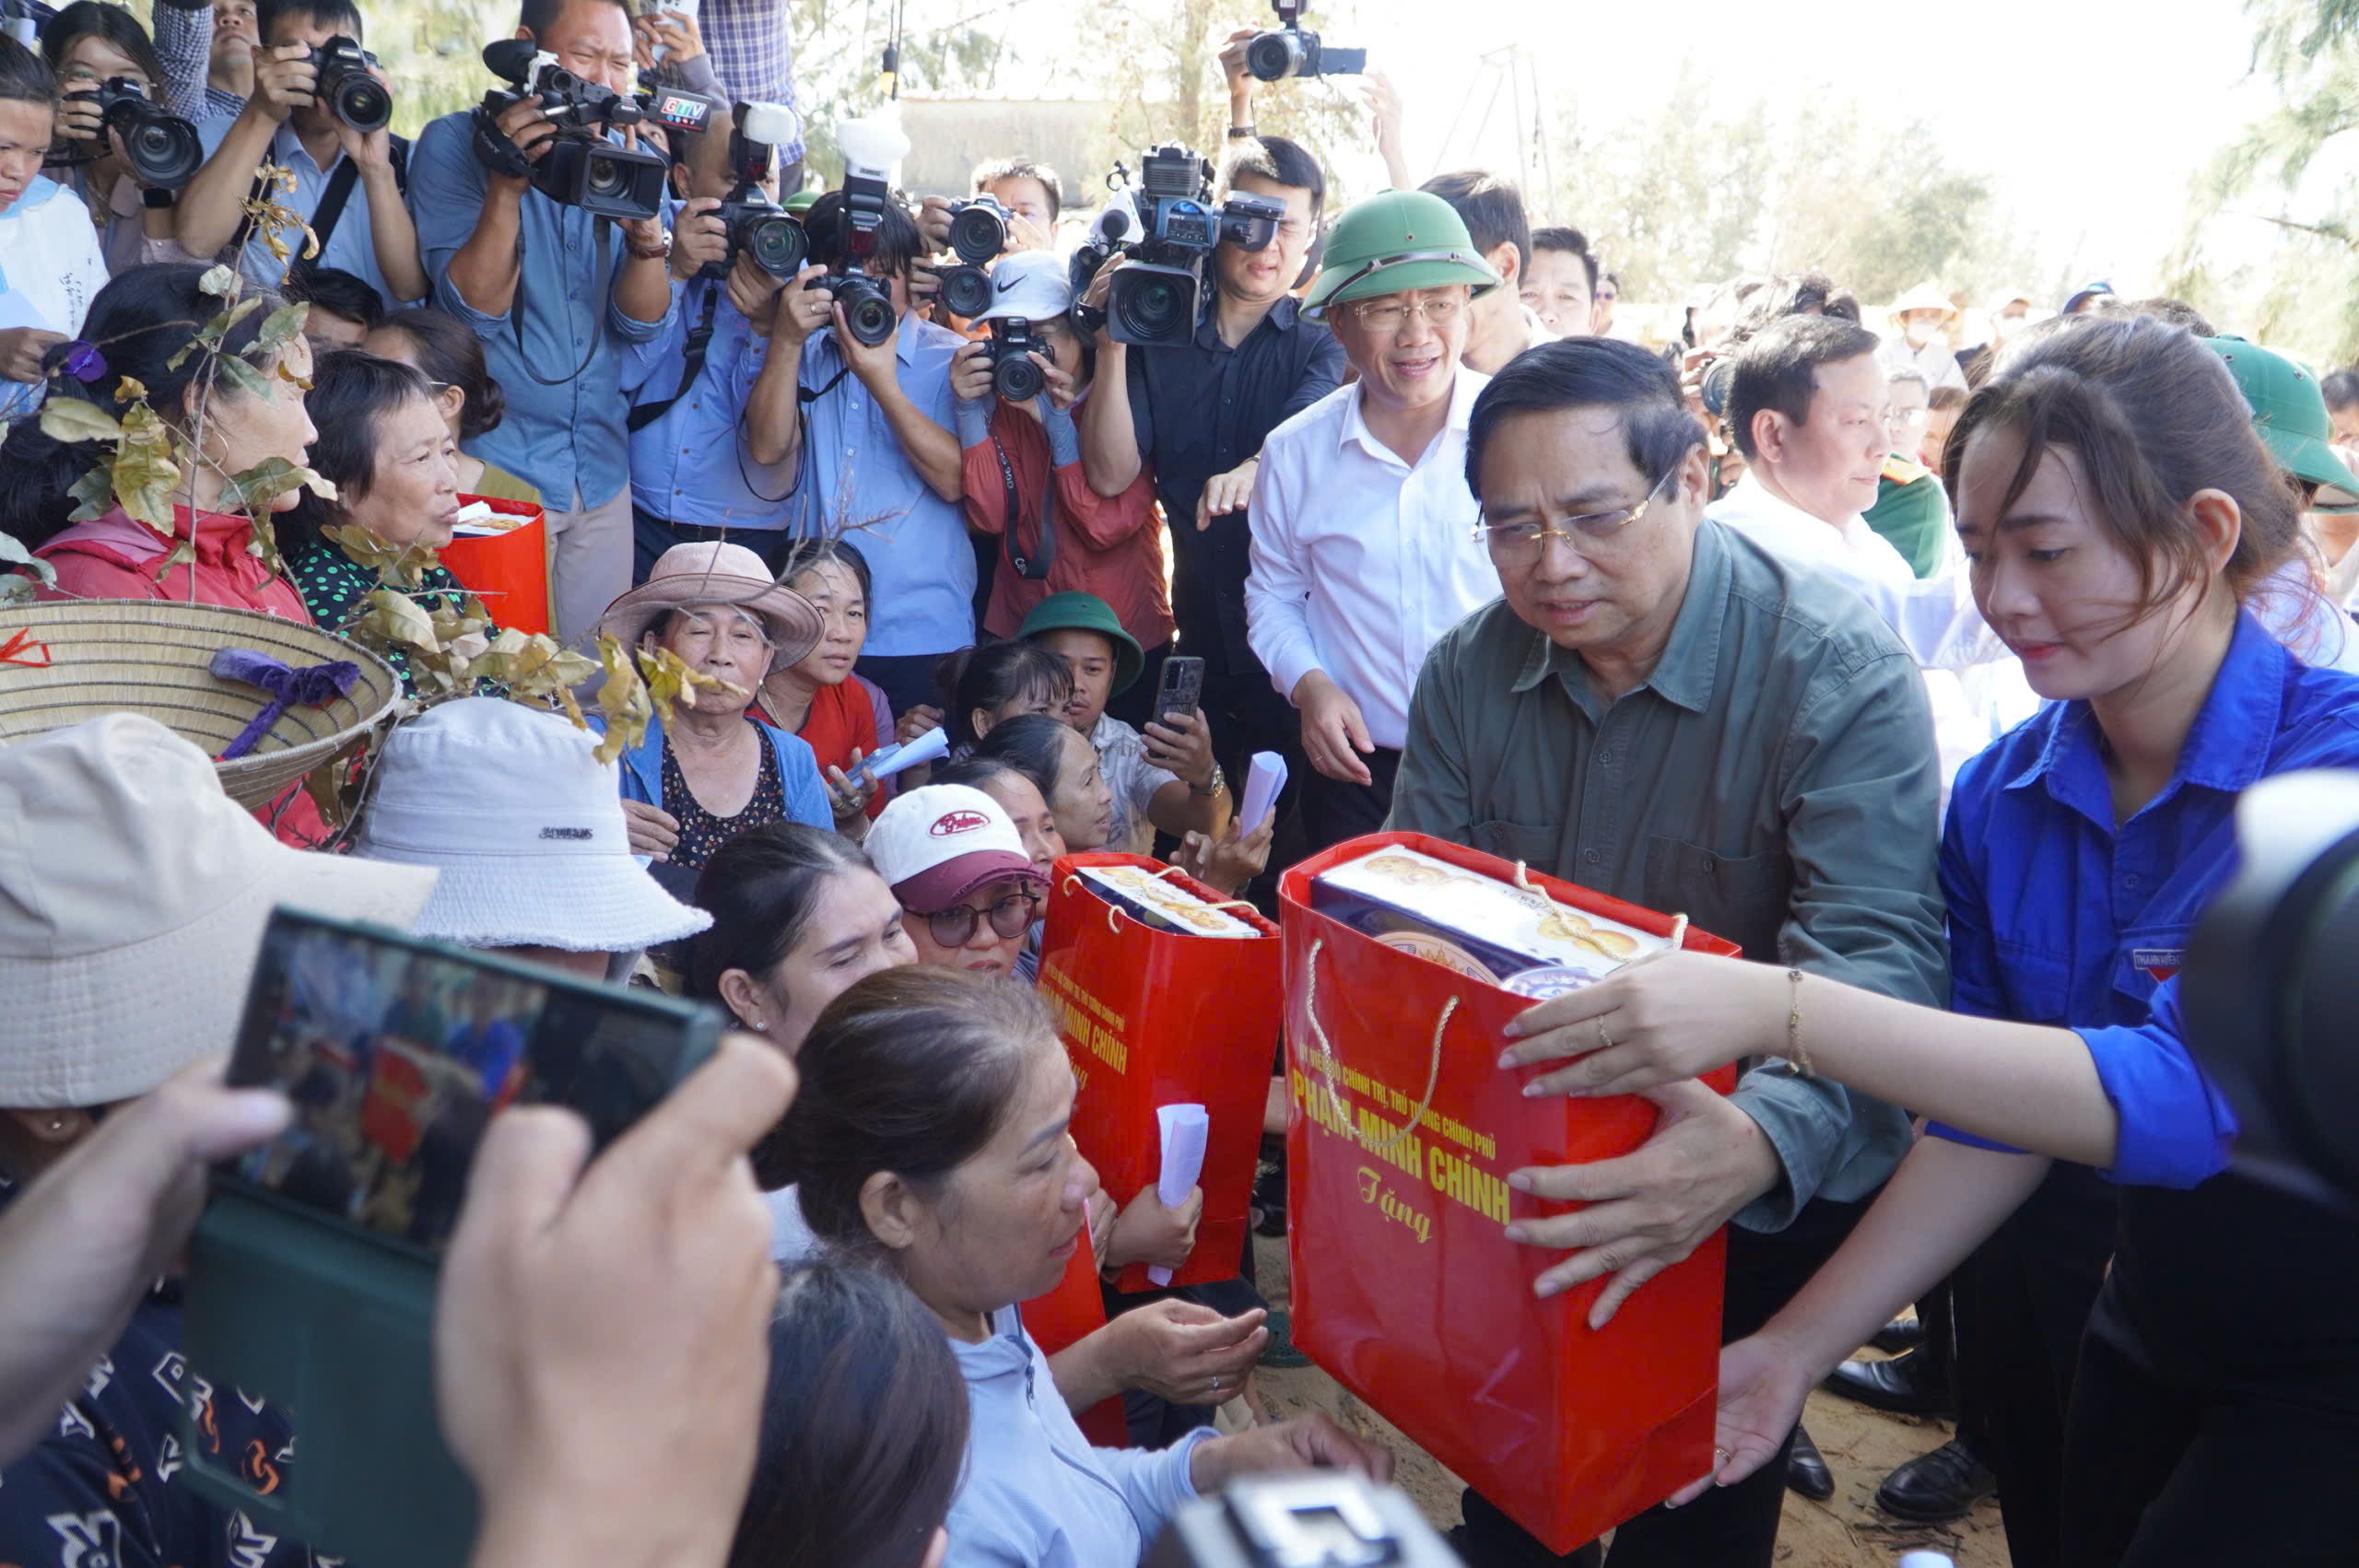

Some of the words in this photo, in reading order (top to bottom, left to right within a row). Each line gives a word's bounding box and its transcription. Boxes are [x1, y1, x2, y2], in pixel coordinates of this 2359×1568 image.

[663, 99, 706, 119] GTV
[1091, 1024, 1128, 1076] CHÍNH
[1293, 1068, 1354, 1141] PHẠM
[1358, 1107, 1423, 1179] MINH
[1429, 1146, 1510, 1226] CHÍNH
[1343, 1066, 1370, 1096] CHÍNH
[1391, 1089, 1408, 1117] THỦ
[1442, 1116, 1473, 1150] CHÍNH
[1474, 1133, 1496, 1161] PHỦ
[1357, 1165, 1432, 1244] Tặng
